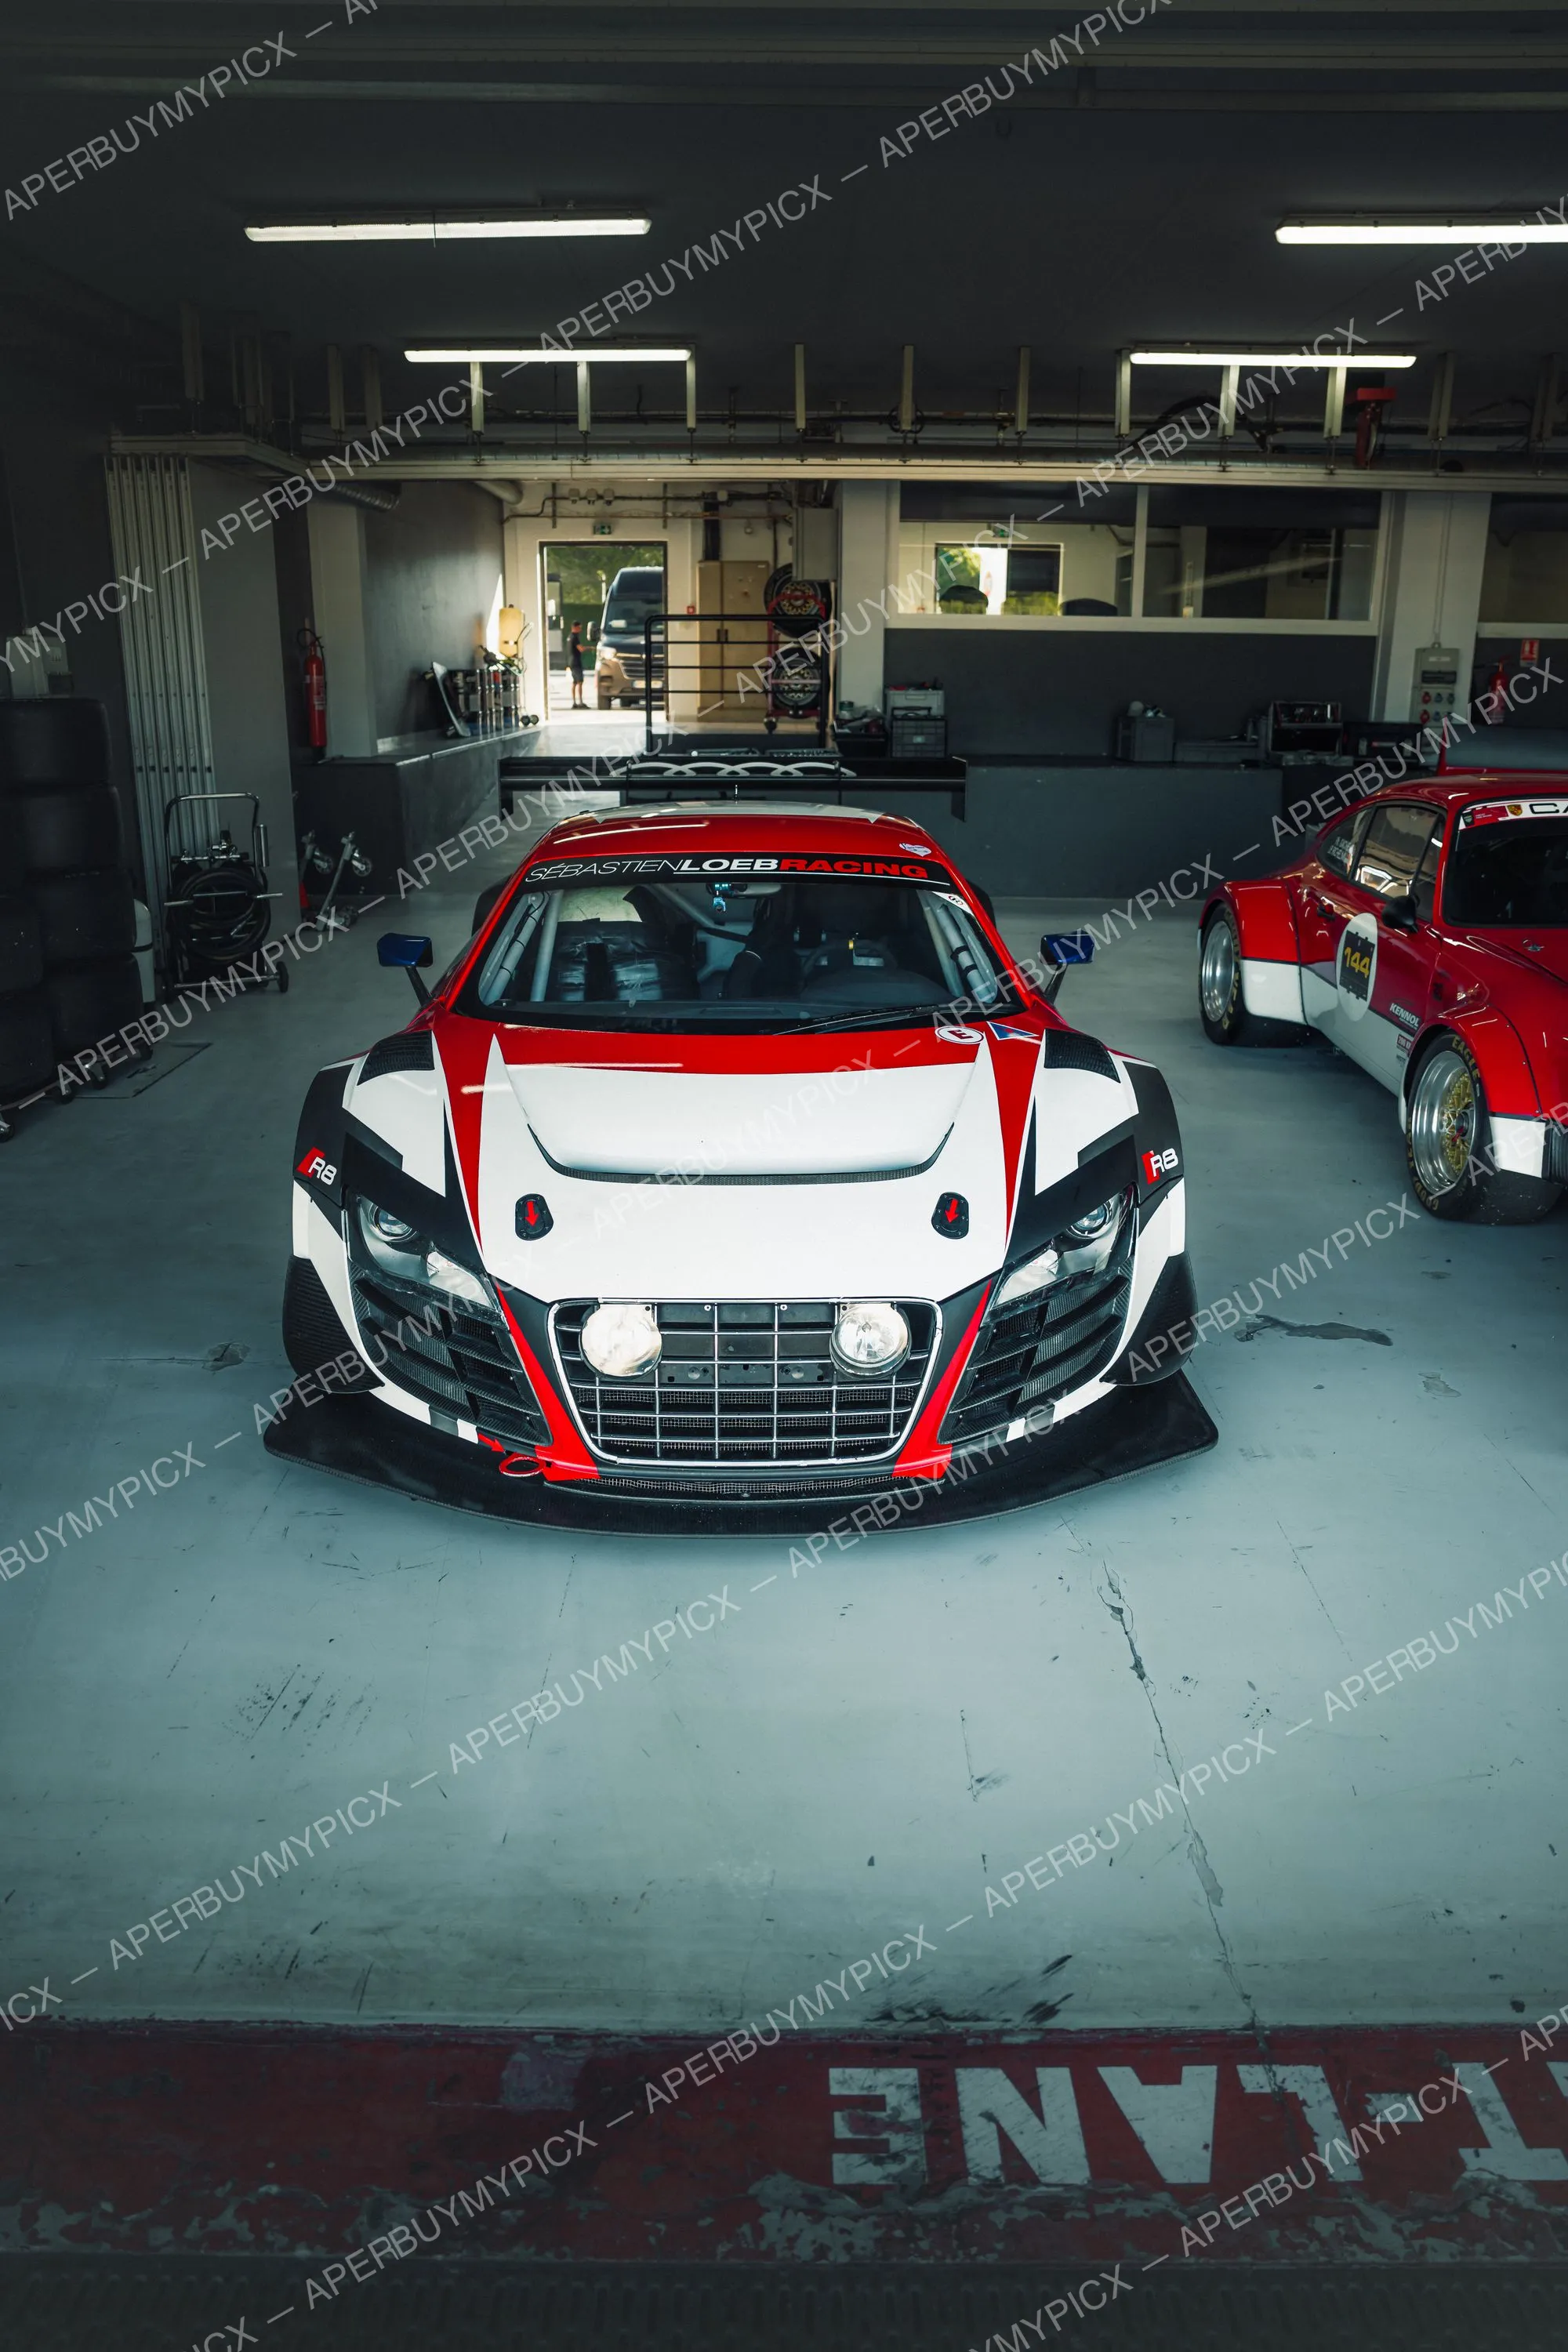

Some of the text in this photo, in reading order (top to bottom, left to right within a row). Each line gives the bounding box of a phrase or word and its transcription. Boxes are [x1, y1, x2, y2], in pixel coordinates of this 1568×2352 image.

[1345, 946, 1370, 978] 144
[1389, 1003, 1420, 1028] KENNOL
[1452, 1035, 1480, 1080] EAGLE
[307, 1156, 337, 1185] R8
[1150, 1148, 1178, 1178] R8
